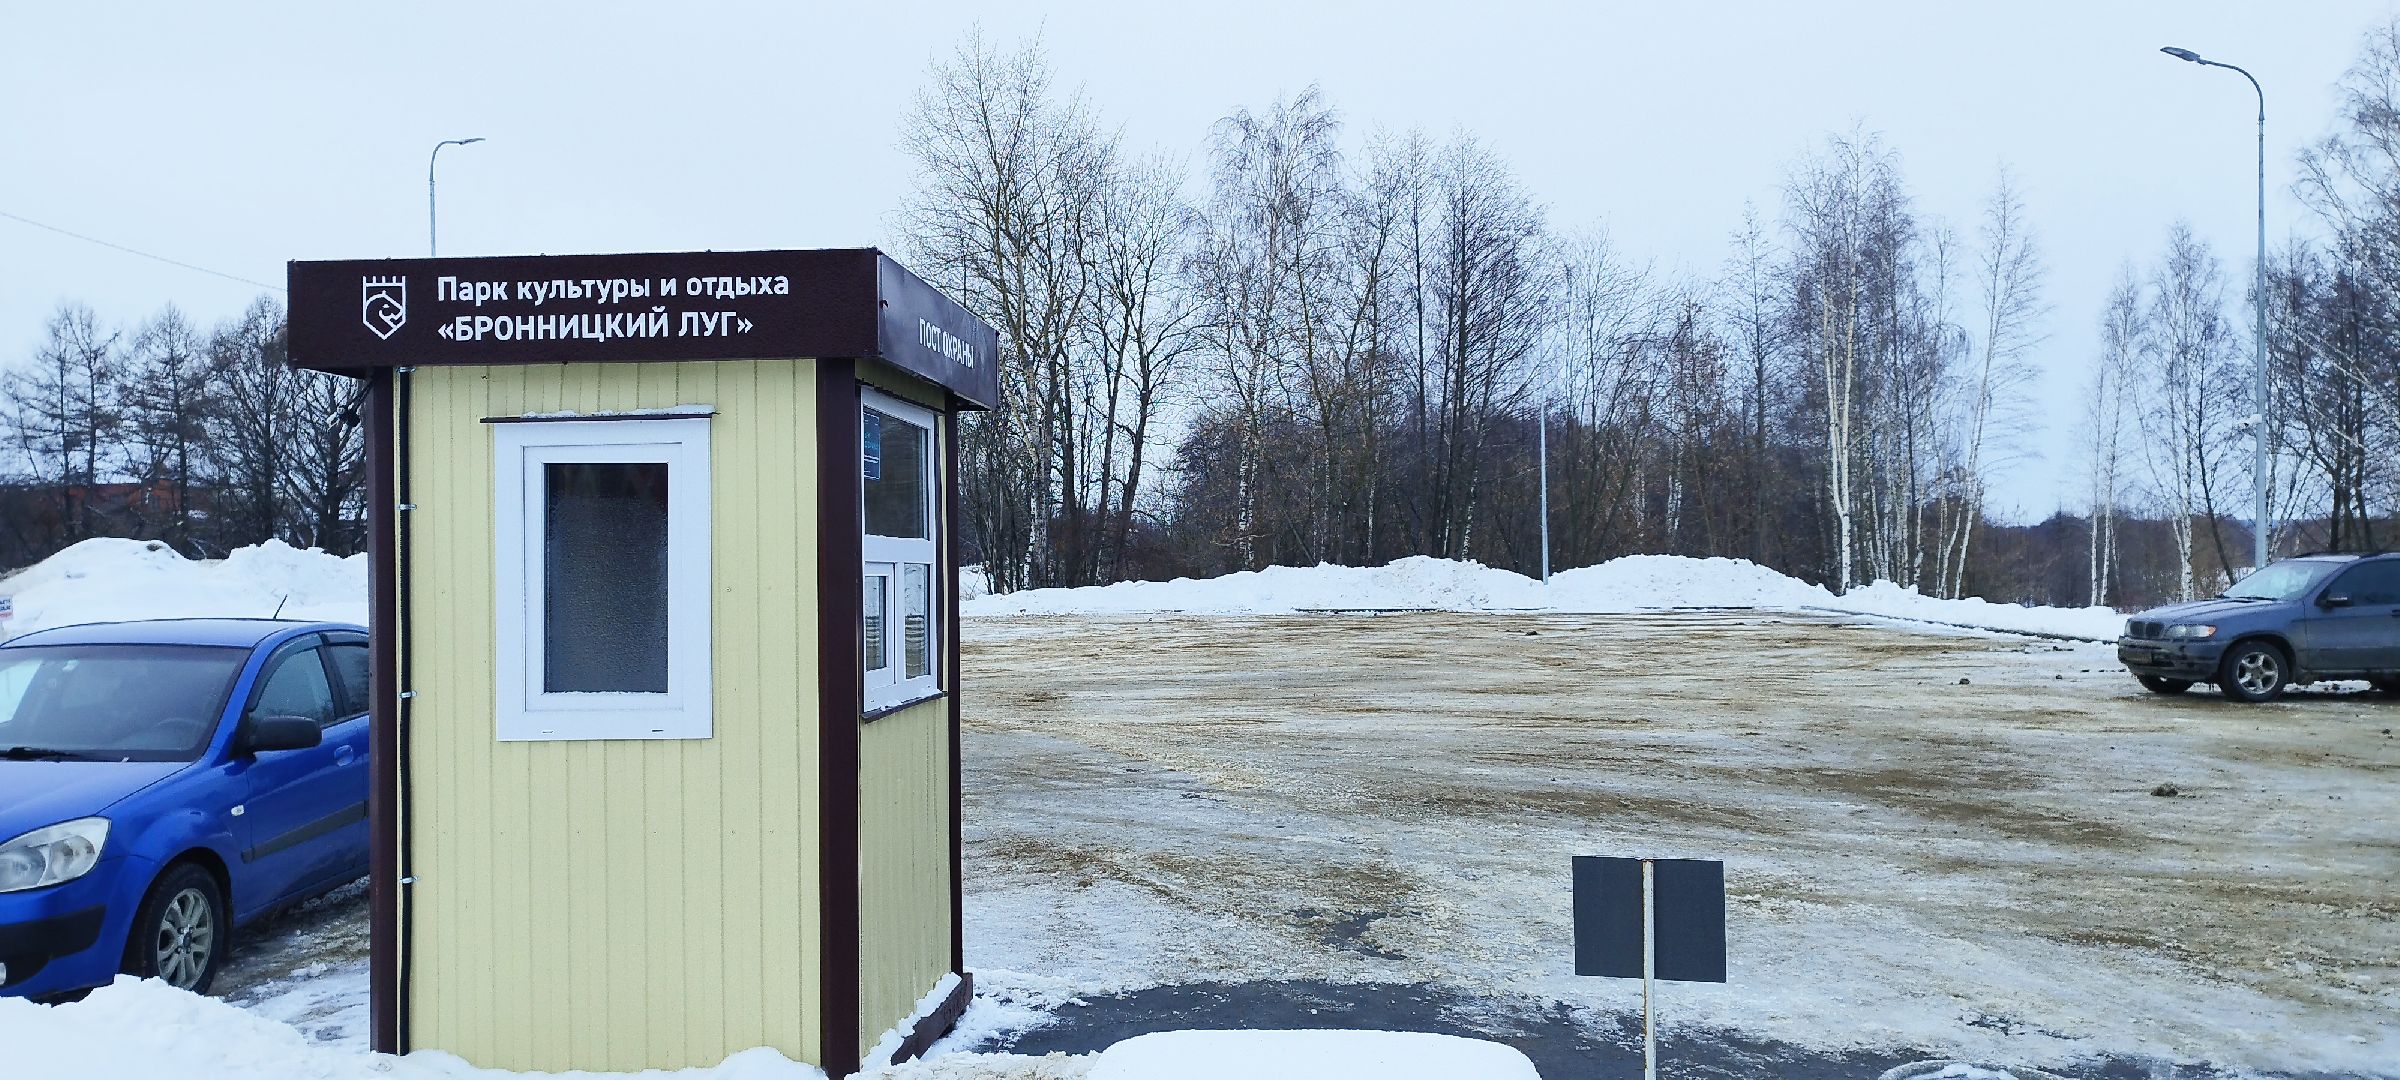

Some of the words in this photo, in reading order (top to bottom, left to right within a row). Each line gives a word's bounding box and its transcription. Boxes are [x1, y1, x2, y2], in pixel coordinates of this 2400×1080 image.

[437, 275, 509, 307] Парк
[517, 277, 651, 307] культуры
[659, 277, 677, 297] и
[686, 275, 789, 300] отдыха
[437, 306, 670, 343] «БРОННИЦКИЙ
[678, 311, 754, 337] ЛУГ»
[919, 317, 941, 353] ПОСТ
[942, 331, 974, 369] ОХРАНЫ
